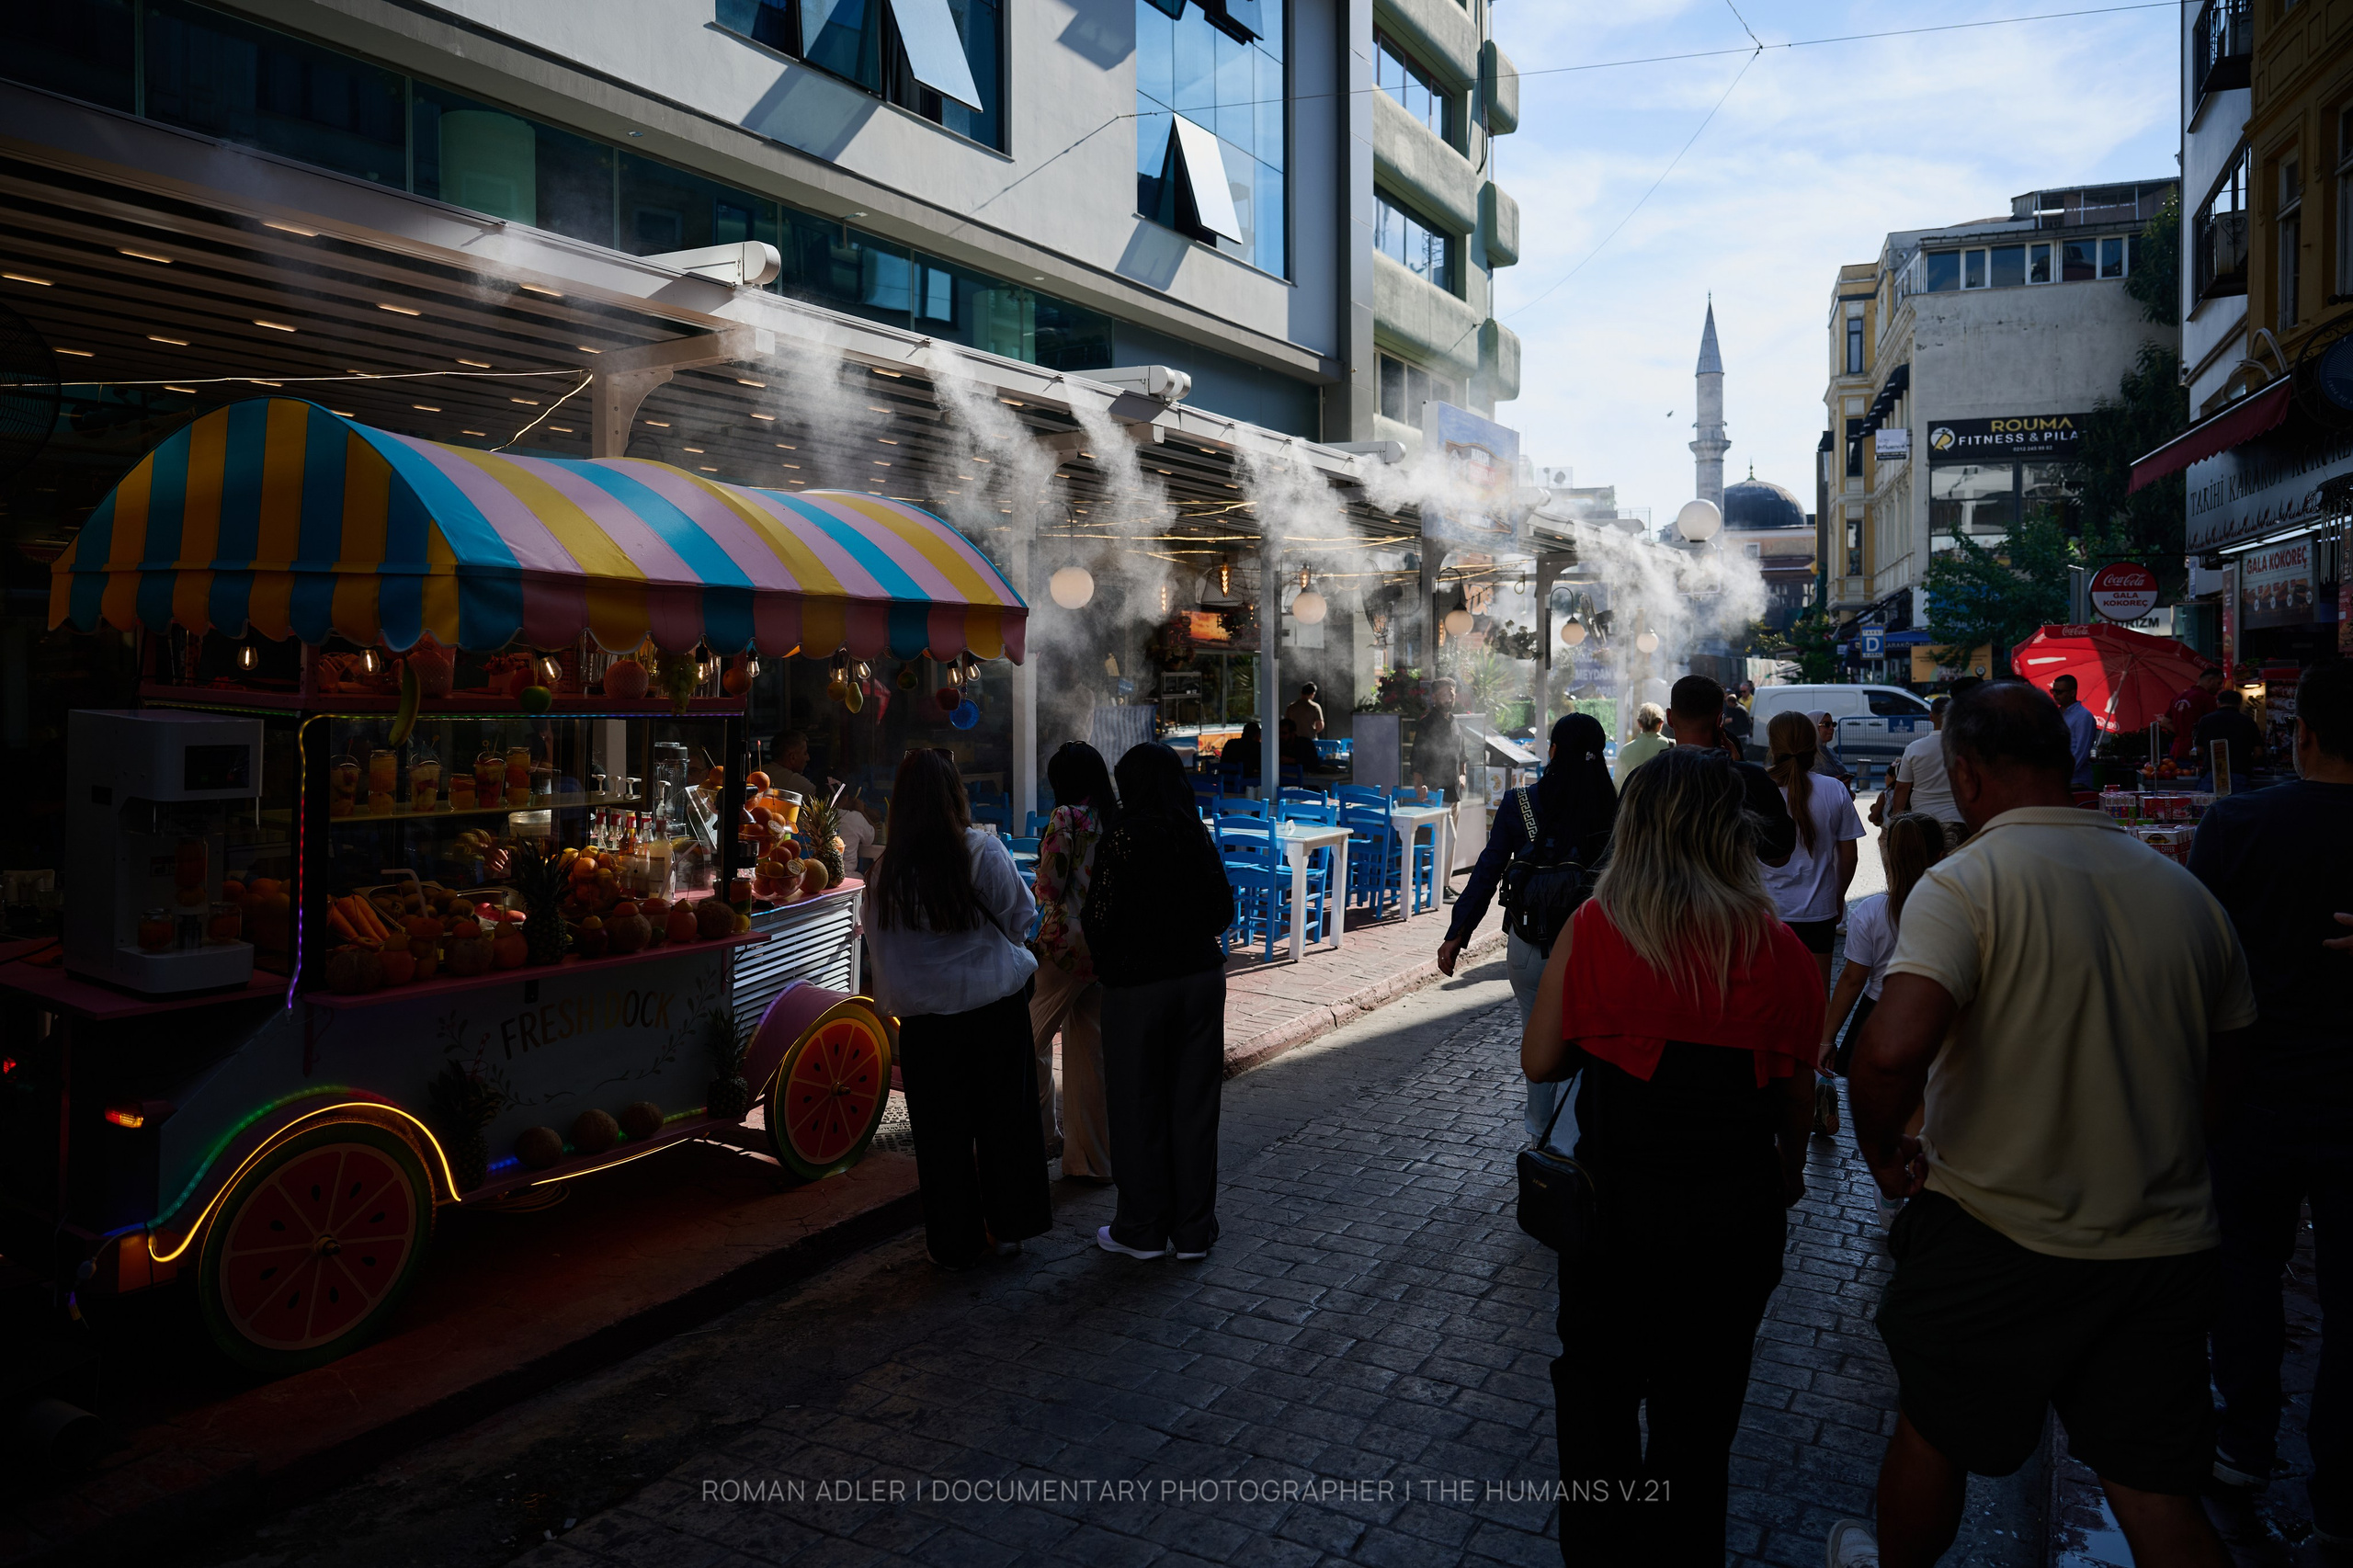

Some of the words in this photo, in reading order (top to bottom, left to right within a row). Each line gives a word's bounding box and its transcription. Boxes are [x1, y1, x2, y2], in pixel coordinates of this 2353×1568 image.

[1991, 416, 2074, 433] ROUMA
[1959, 433, 2025, 447] FITNESS
[2029, 432, 2039, 442] &
[2044, 429, 2082, 442] PILA
[2246, 557, 2268, 574] GALA
[2268, 545, 2307, 569] KOKOREÇ
[2103, 573, 2147, 587] Coca-Cola
[1866, 637, 1880, 652] D
[500, 992, 595, 1060] FRESH
[604, 989, 676, 1030] DOCK
